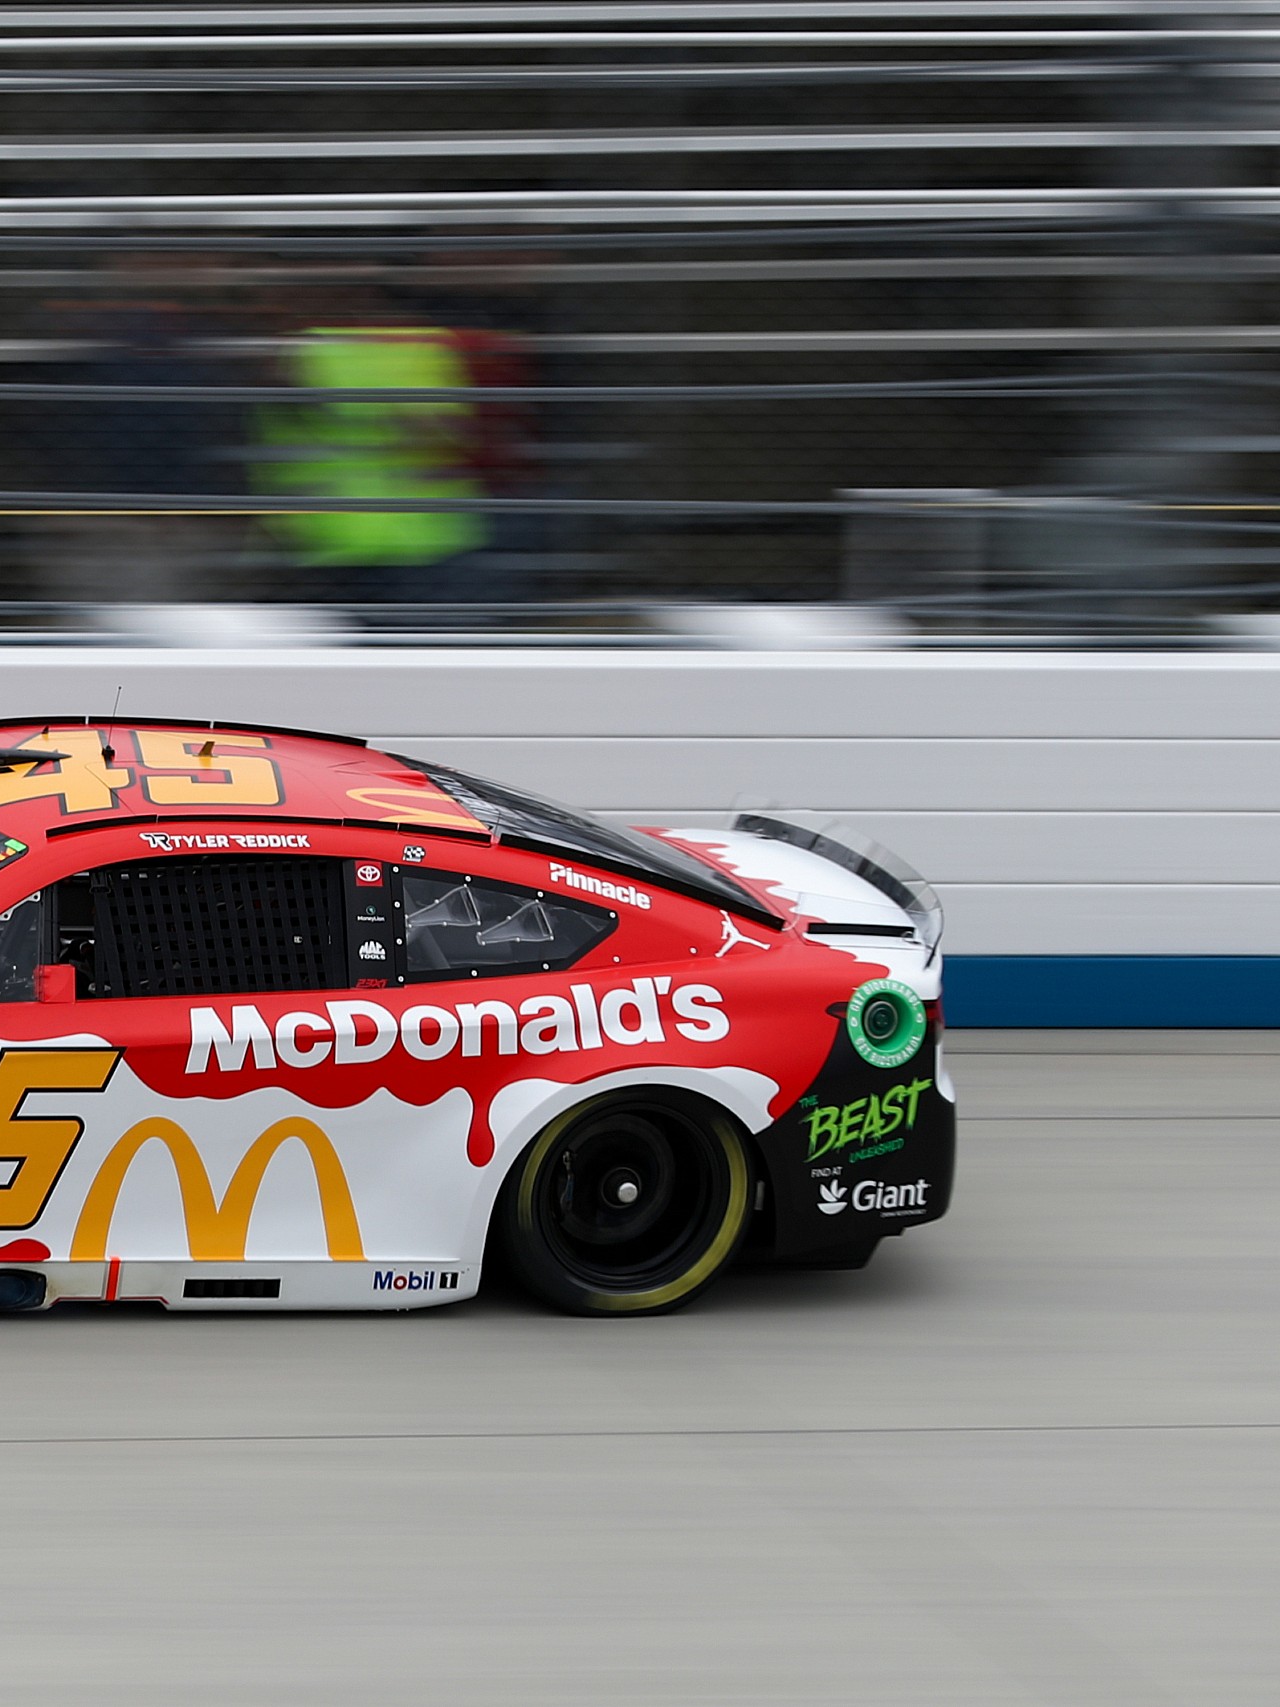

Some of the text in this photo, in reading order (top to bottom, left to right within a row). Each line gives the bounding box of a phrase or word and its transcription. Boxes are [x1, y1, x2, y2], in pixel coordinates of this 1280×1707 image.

[170, 835, 229, 848] TYLER
[229, 835, 311, 848] REDDICK
[548, 862, 651, 910] Pinnacle
[185, 975, 731, 1075] McDonald's
[802, 1077, 933, 1163] BEAST
[811, 1166, 843, 1178] FIND AT
[852, 1178, 928, 1211] Giant
[373, 1271, 435, 1290] Mobil
